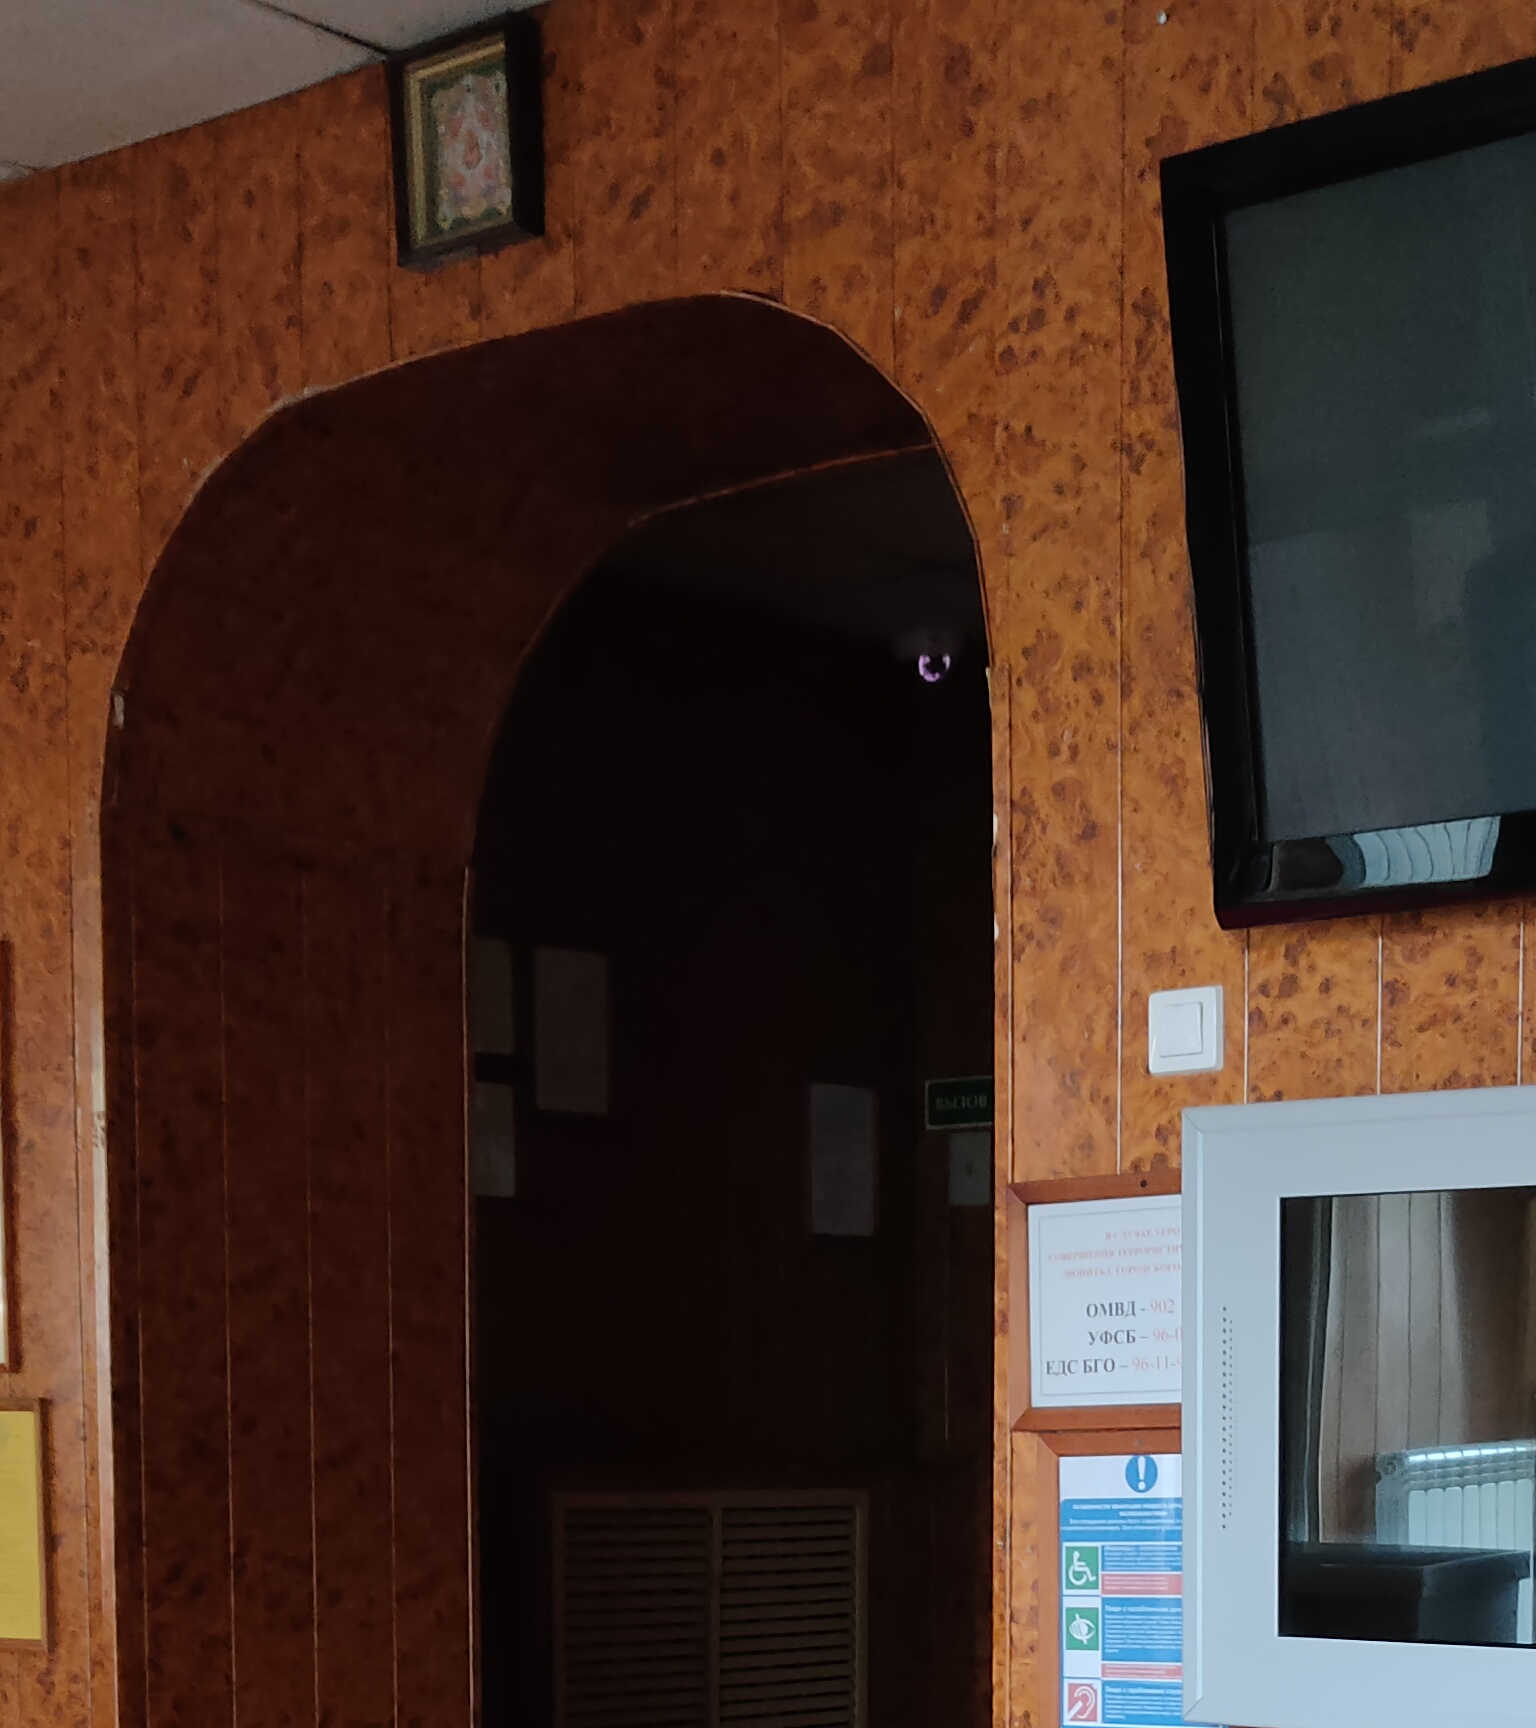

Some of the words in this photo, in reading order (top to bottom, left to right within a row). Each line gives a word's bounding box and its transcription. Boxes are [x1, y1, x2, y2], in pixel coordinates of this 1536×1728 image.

[1086, 1301, 1137, 1318] ОМВД
[1150, 1299, 1175, 1314] 902
[1087, 1329, 1136, 1346] УФСБ
[1045, 1359, 1079, 1377] ЕДС
[1083, 1358, 1116, 1374] БГО
